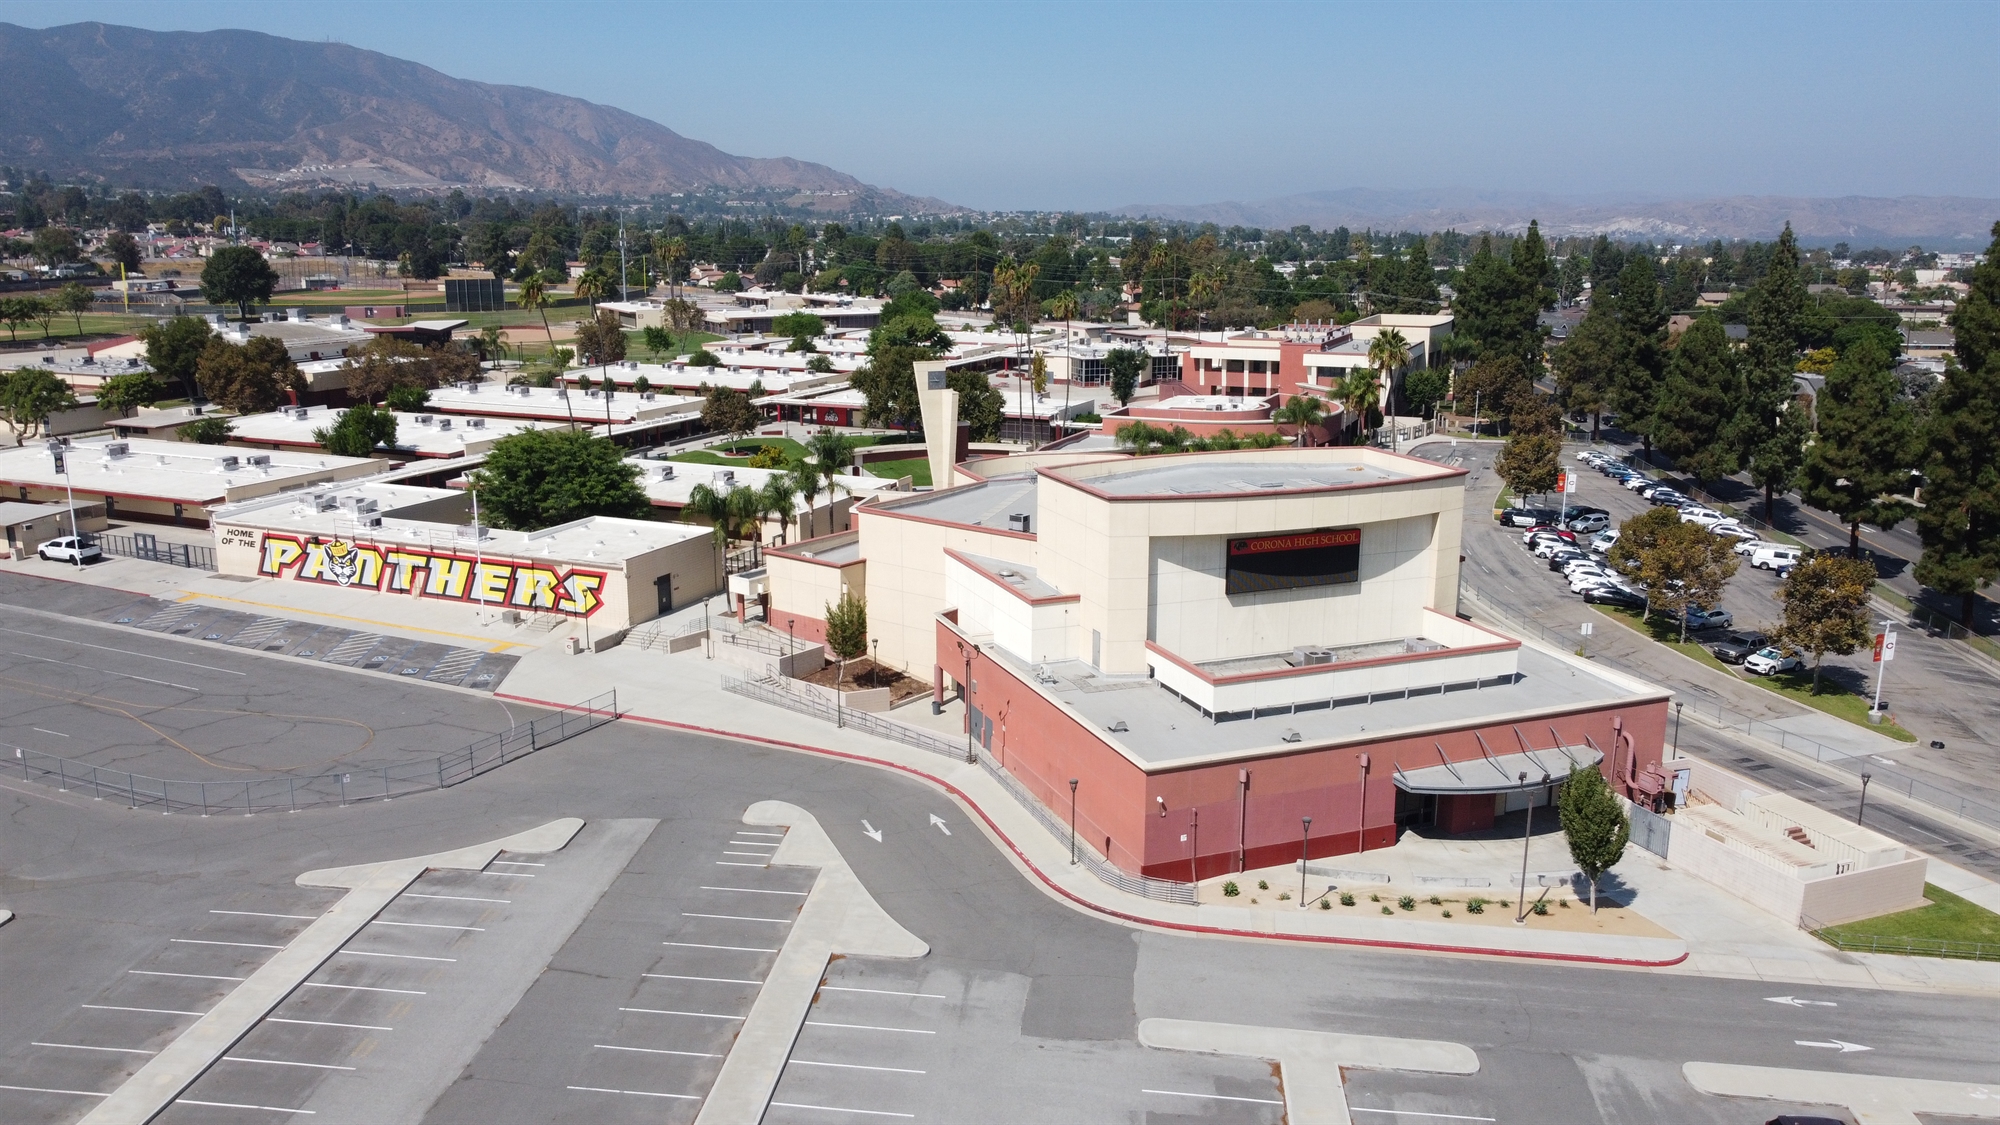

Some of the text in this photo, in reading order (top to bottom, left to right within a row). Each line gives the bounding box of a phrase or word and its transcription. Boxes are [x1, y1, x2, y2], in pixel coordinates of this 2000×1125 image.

[227, 528, 254, 538] HOME
[238, 539, 256, 548] THE
[1250, 533, 1358, 550] CORONA HIGH SCHOOL
[258, 532, 606, 618] PANTHERS
